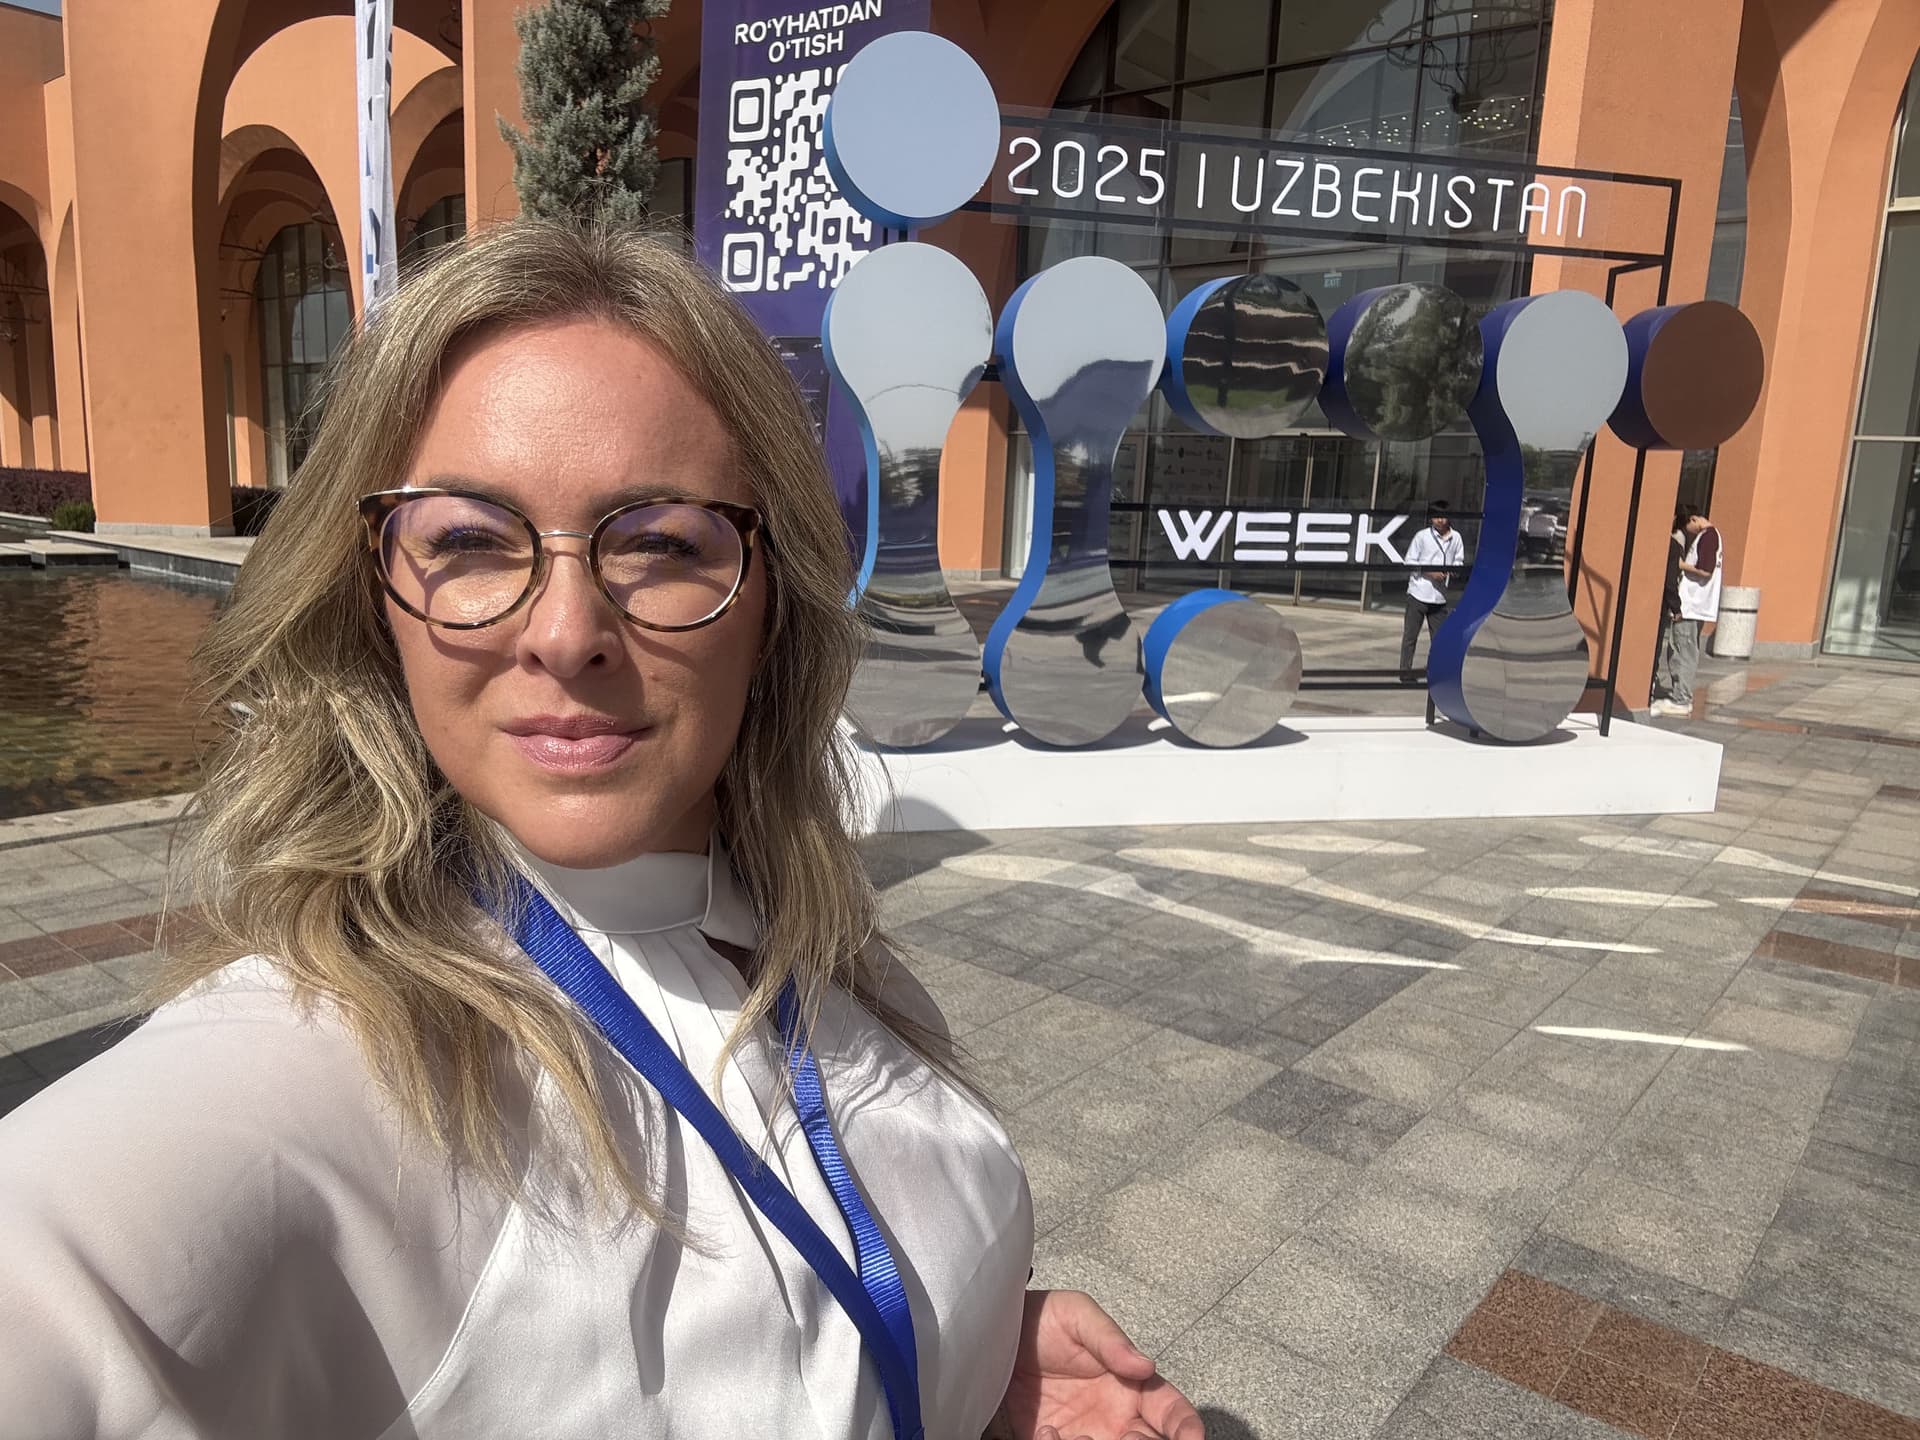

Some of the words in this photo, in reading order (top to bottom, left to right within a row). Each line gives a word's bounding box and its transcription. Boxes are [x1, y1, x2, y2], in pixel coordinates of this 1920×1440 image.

[1007, 136, 1166, 205] 2025
[1231, 155, 1587, 238] UZBEKISTAN
[1157, 509, 1409, 565] WEEK
